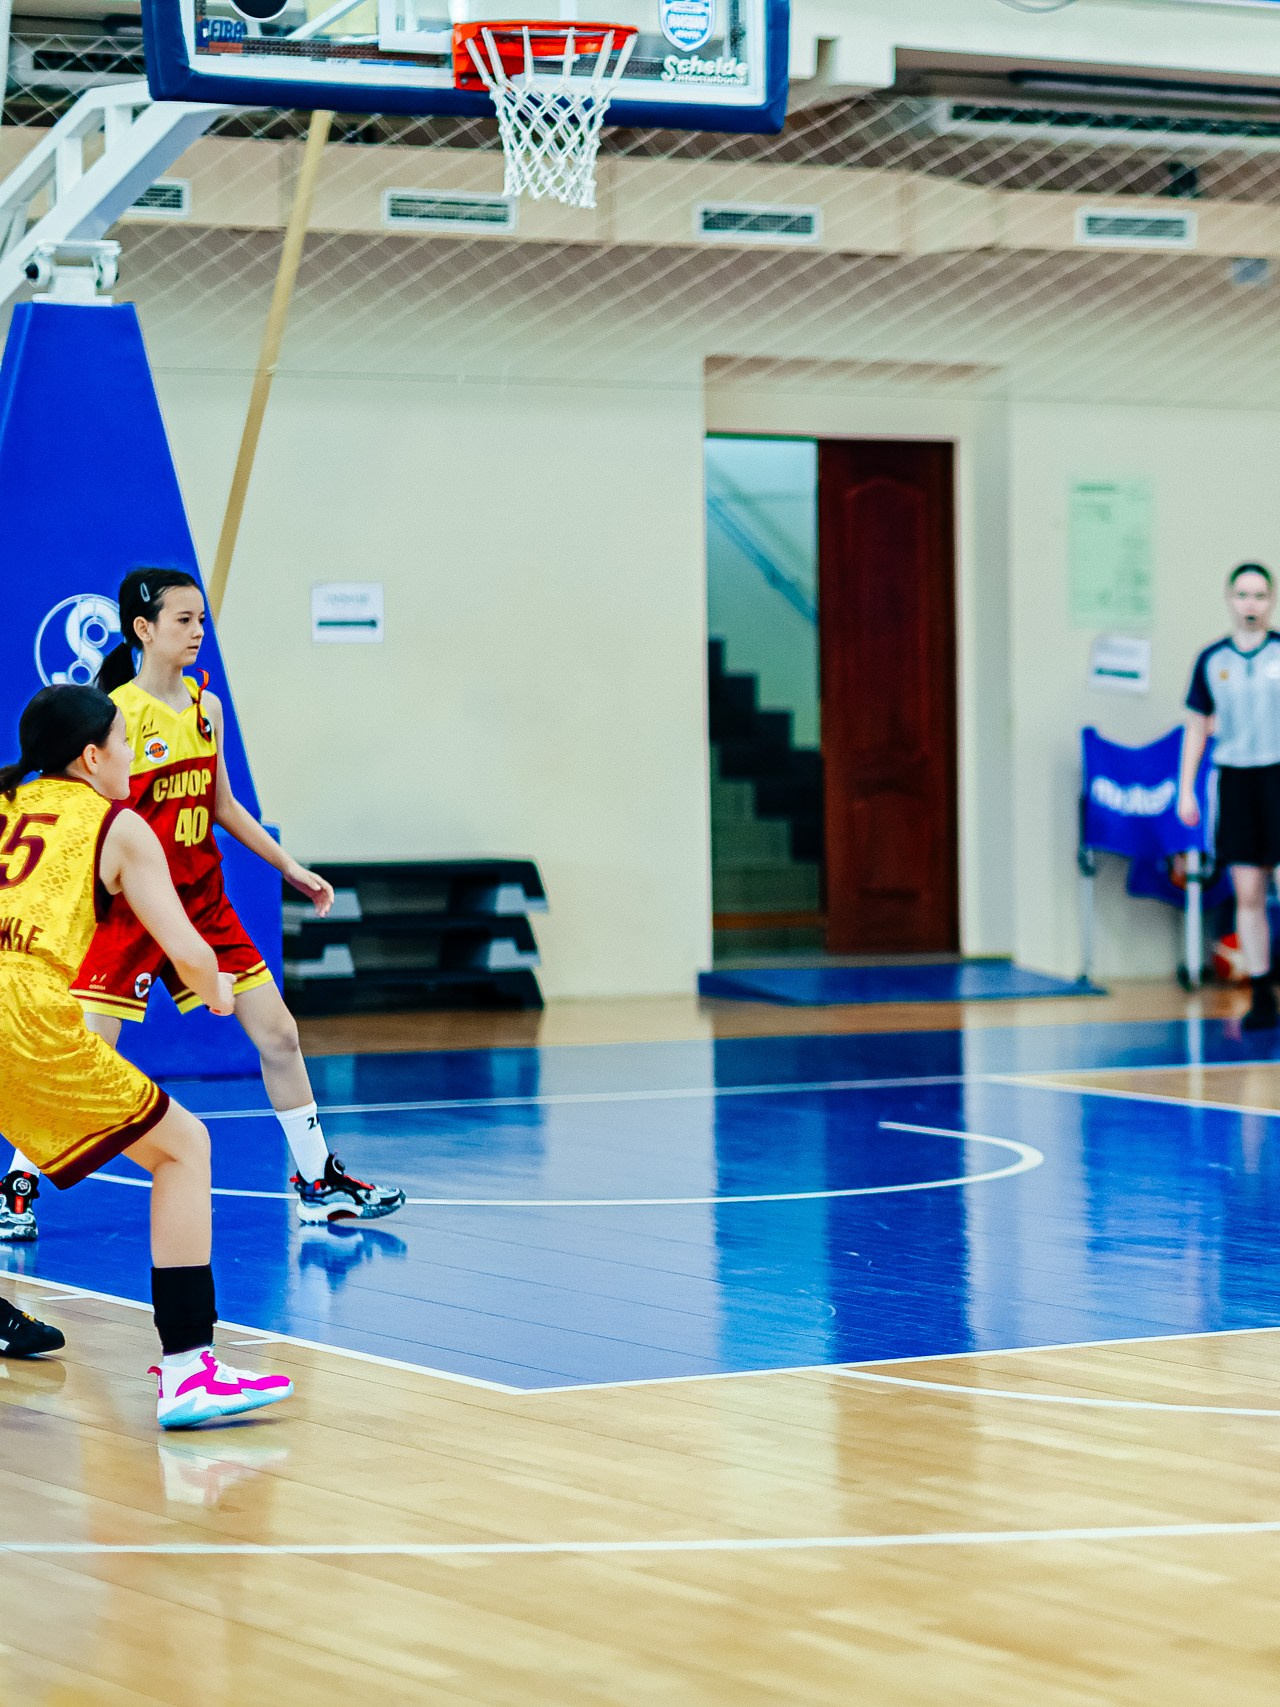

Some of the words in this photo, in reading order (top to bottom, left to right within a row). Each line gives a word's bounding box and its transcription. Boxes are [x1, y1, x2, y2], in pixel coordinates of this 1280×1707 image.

[661, 55, 748, 81] Schelde
[153, 768, 212, 803] СШОР
[175, 806, 209, 848] 40
[0, 812, 60, 890] 5
